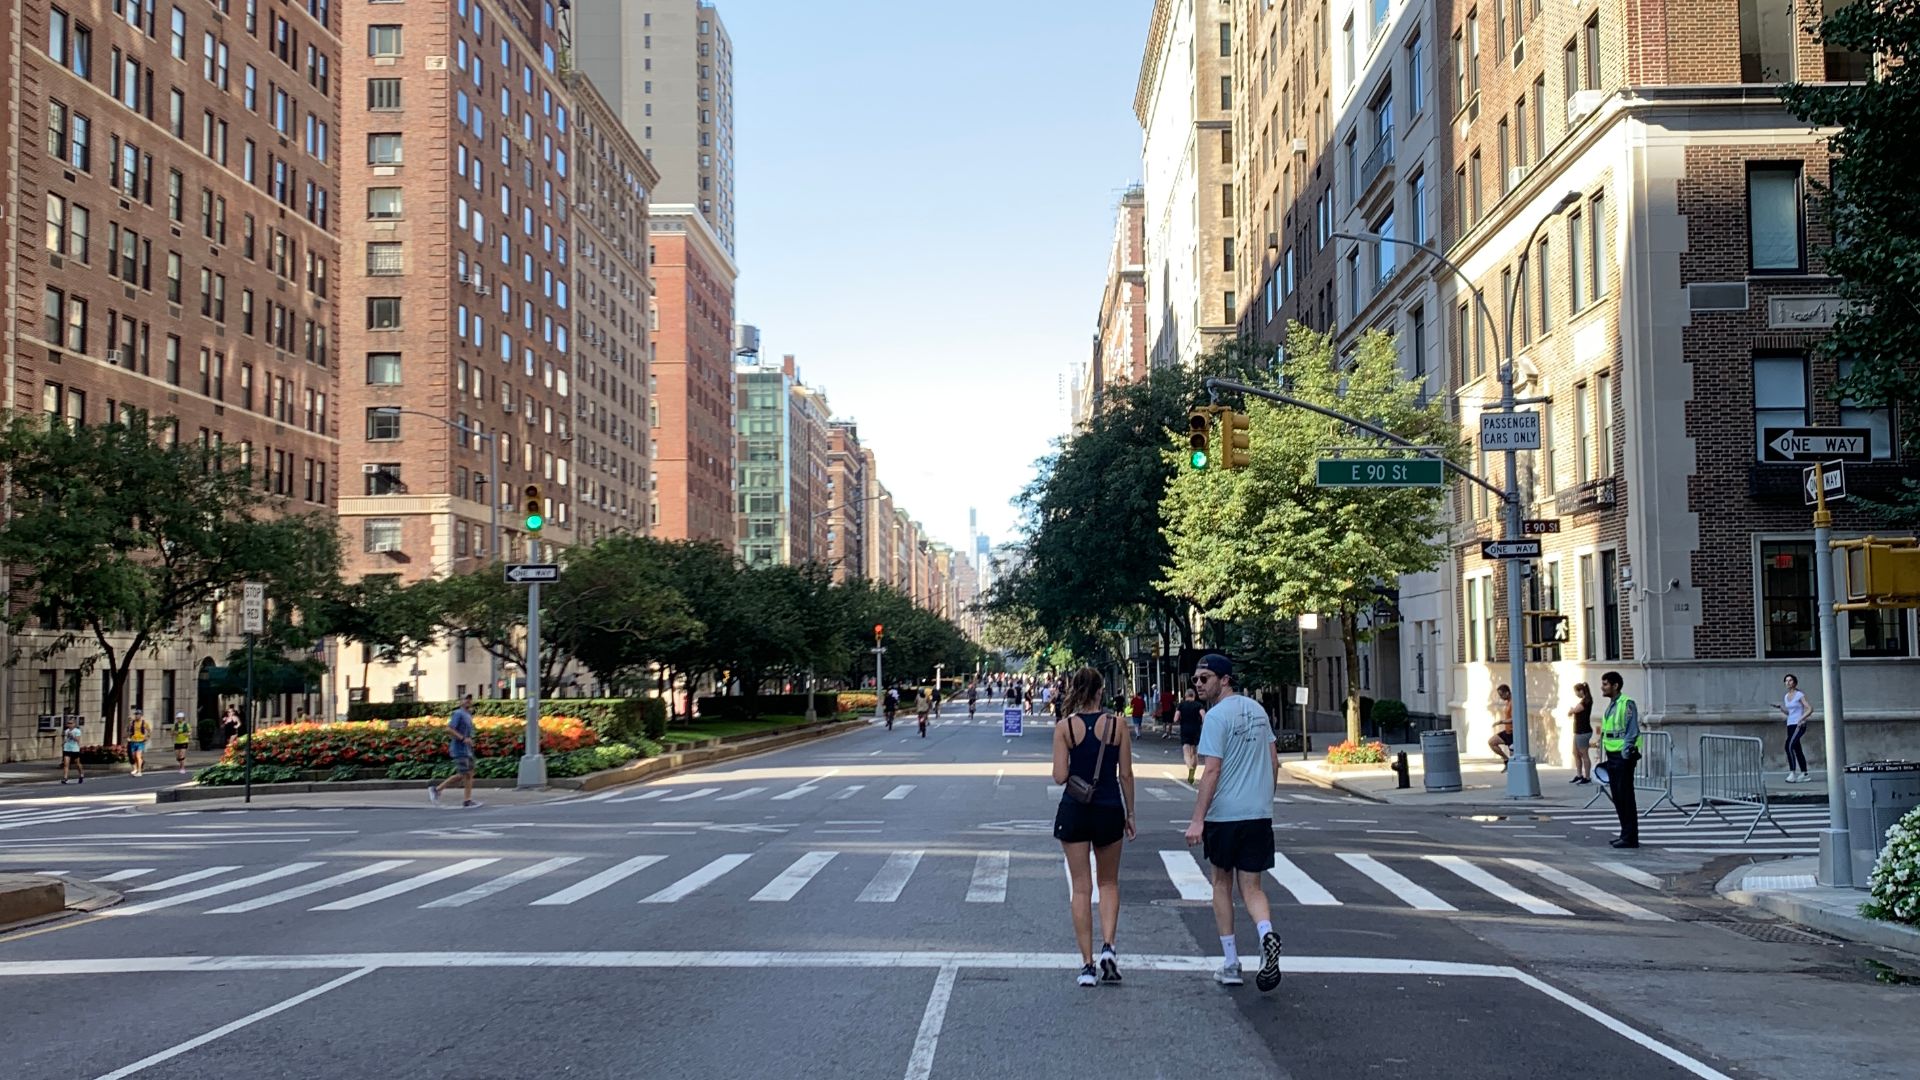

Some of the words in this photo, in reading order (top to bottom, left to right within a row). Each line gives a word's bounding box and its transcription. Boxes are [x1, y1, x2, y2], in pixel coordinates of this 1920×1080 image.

[1484, 416, 1536, 429] PASSENGER
[1484, 432, 1508, 444] CARS
[1514, 431, 1536, 443] ONLY
[1780, 438, 1810, 452] ONE
[1825, 438, 1857, 452] WAY
[1352, 465, 1360, 480] E
[1367, 464, 1386, 480] 90
[1392, 464, 1408, 480] St
[1825, 473, 1838, 490] WAY
[1524, 523, 1531, 533] E
[1533, 522, 1546, 532] 90
[1548, 522, 1558, 532] St
[1490, 546, 1508, 554] ONE
[1516, 544, 1534, 553] WAY
[246, 587, 261, 598] STOP
